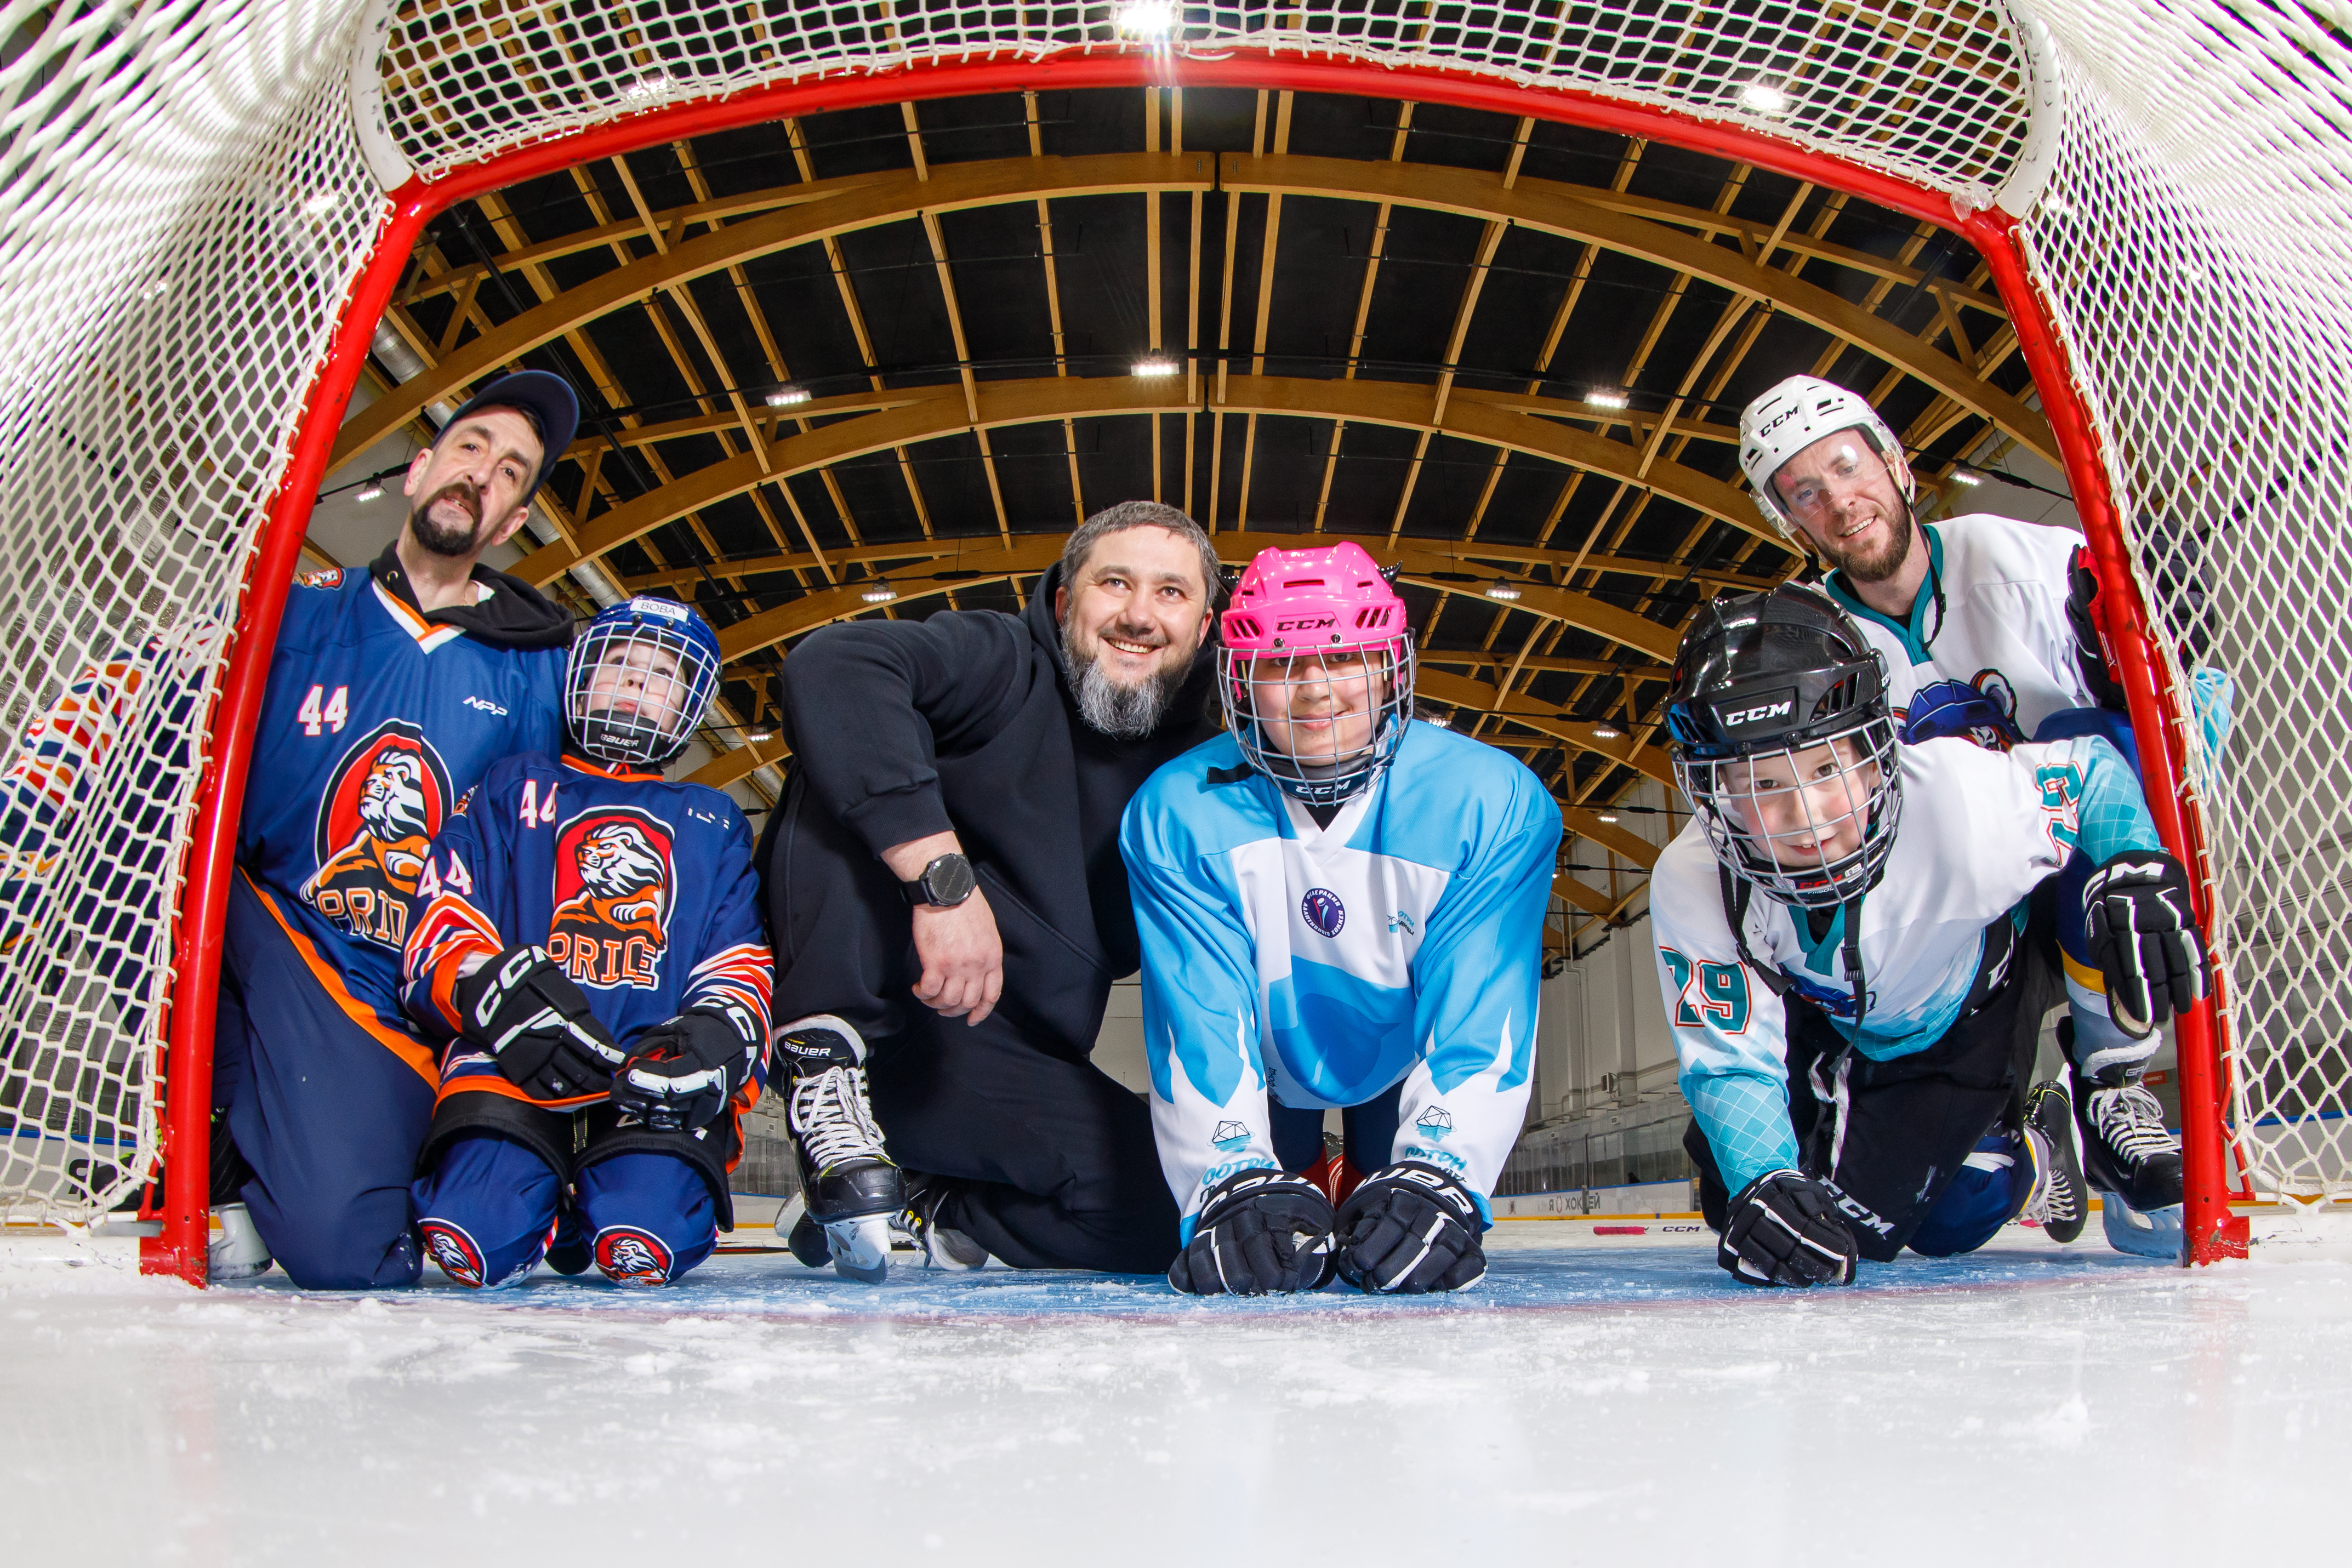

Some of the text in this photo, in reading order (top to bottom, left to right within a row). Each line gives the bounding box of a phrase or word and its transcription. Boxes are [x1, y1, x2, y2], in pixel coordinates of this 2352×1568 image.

[1759, 405, 1799, 437] CCM
[1277, 618, 1335, 631] CCM
[297, 684, 348, 737] 44
[463, 696, 508, 716] NPP
[1726, 701, 1791, 726] CCM
[600, 733, 639, 747] BAUER
[1295, 779, 1351, 794] CCM
[416, 848, 472, 899] 44
[316, 887, 409, 947] PRID
[1331, 910, 1344, 936] ХОККЕЯ
[1659, 946, 1751, 1035] 29
[784, 1041, 831, 1056] BAUER
[1549, 1192, 1601, 1211] Я ХОКЕЙ
[1818, 1174, 1895, 1235] CCM
